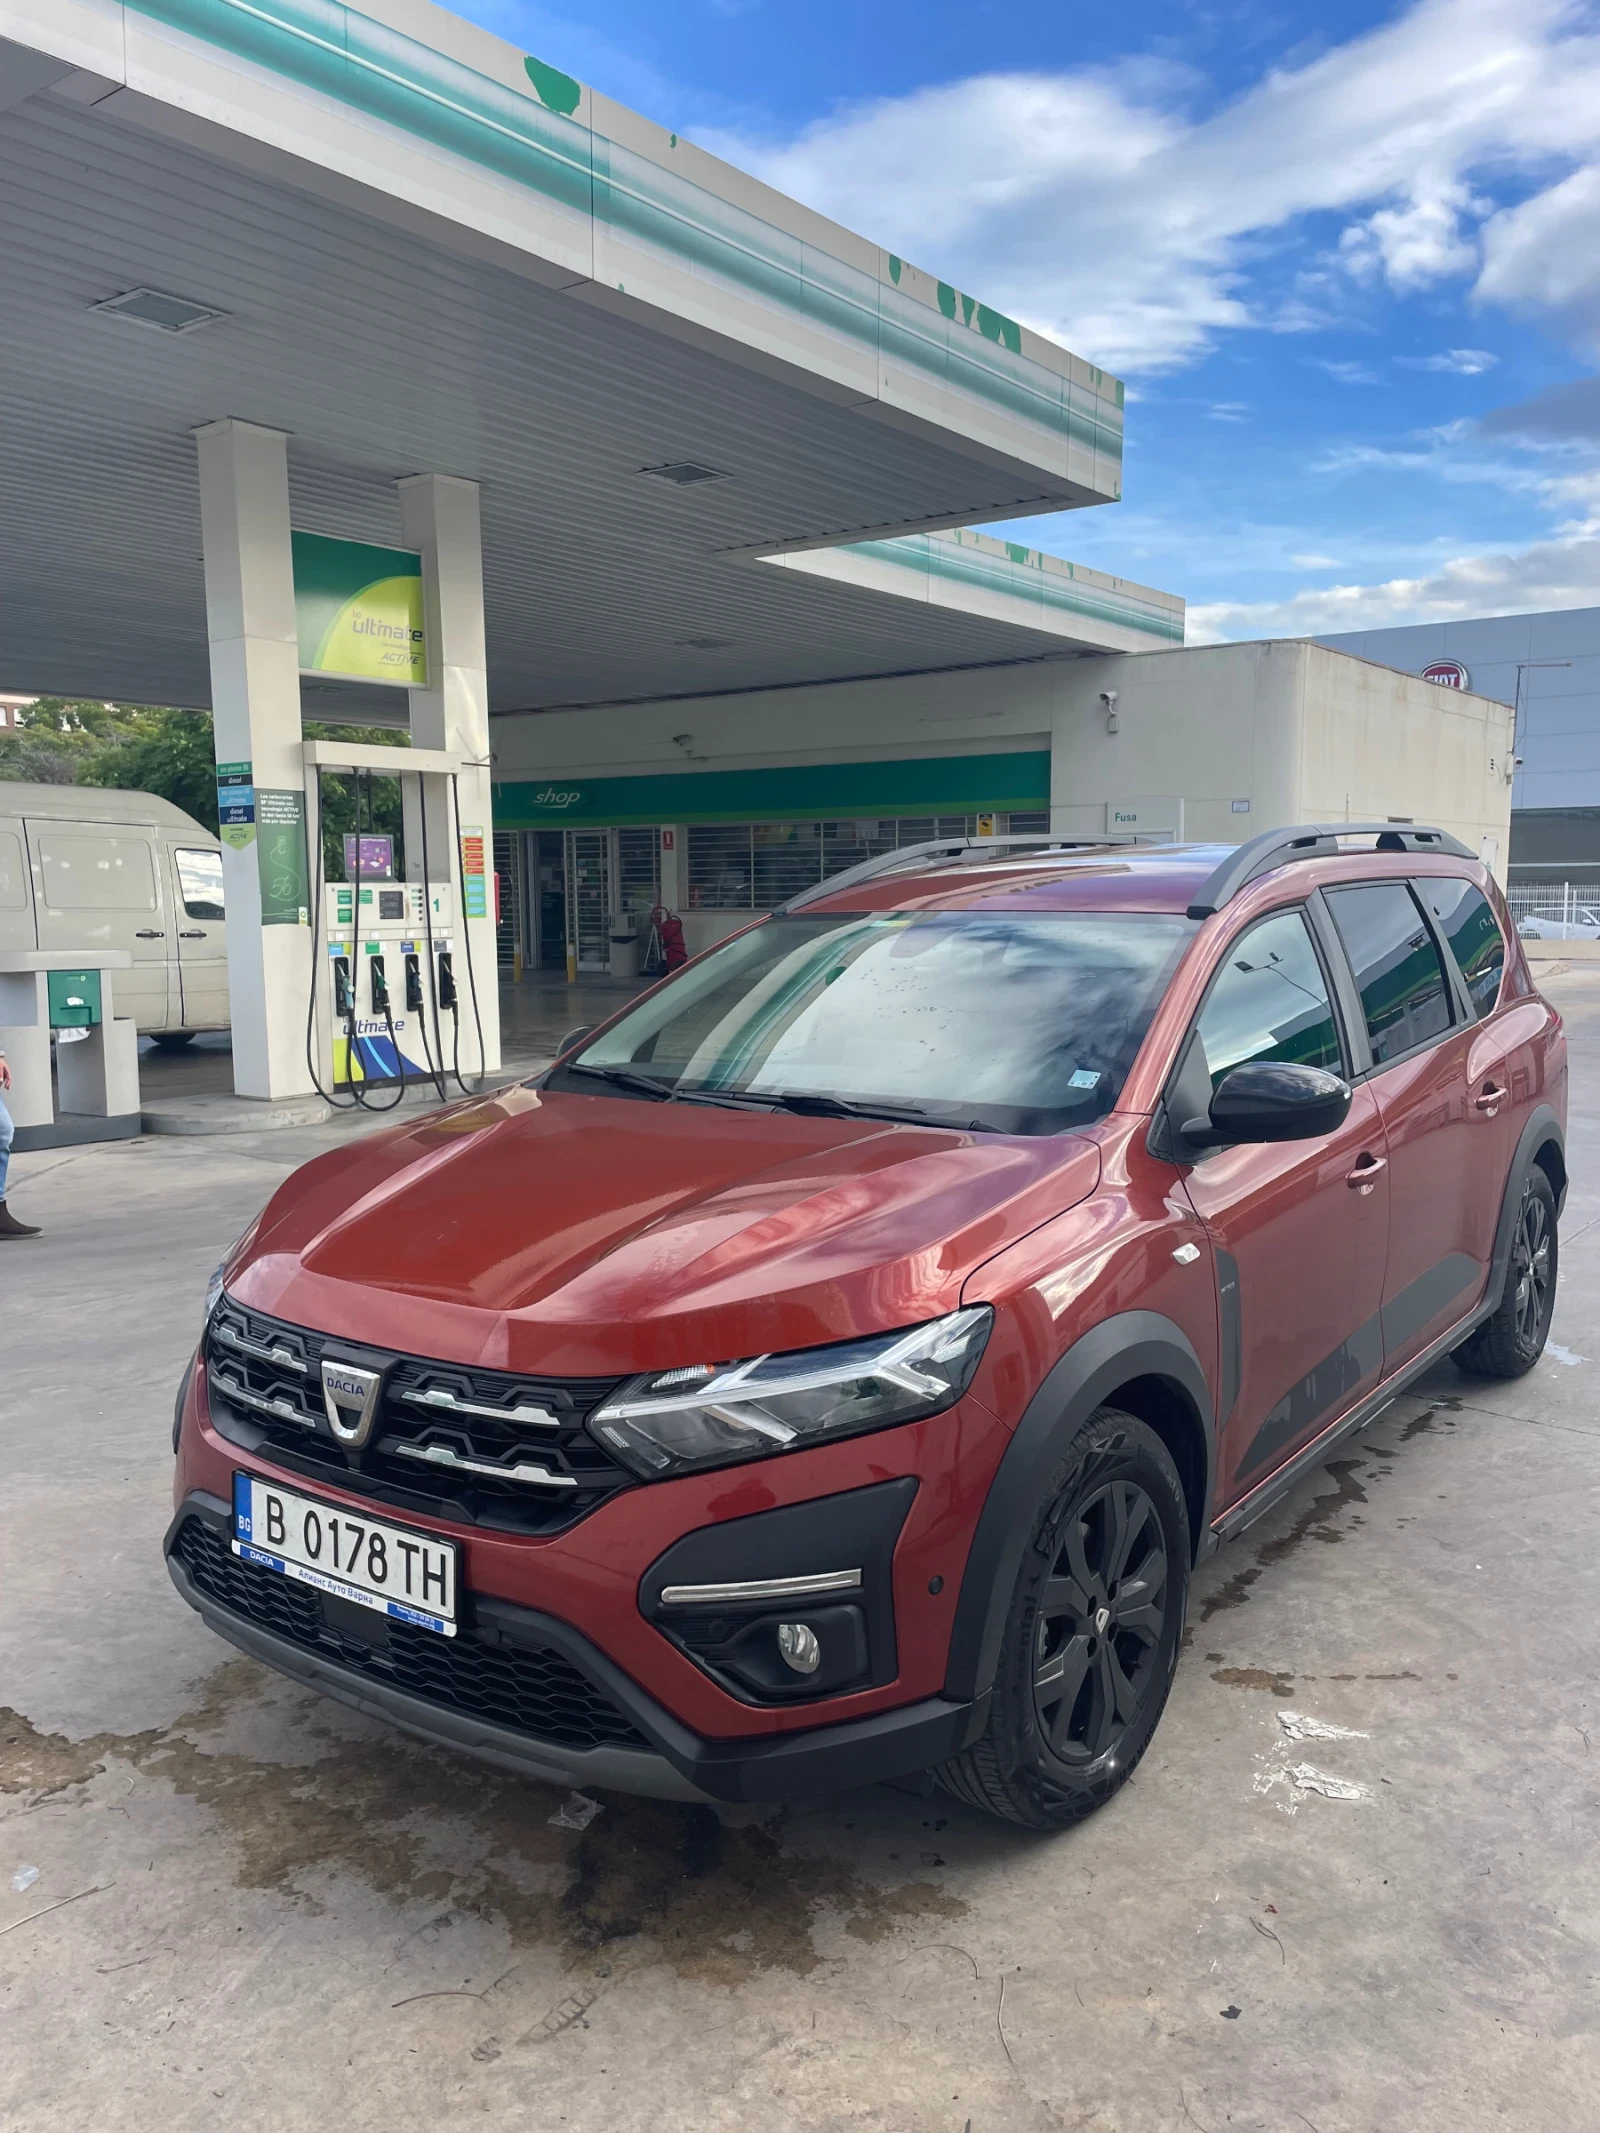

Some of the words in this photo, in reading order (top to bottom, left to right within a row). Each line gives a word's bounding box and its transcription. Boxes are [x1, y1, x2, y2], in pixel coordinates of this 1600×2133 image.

[352, 618, 423, 642] ultimate
[381, 652, 420, 665] ACTIVE
[1427, 674, 1457, 688] IAT
[533, 788, 580, 808] shop
[1114, 812, 1137, 822] Fusa
[433, 898, 440, 912] 1
[343, 1019, 405, 1035] utimae
[327, 1376, 365, 1397] DACIA
[238, 1514, 251, 1532] BG
[250, 1551, 274, 1567] DACIA
[267, 1494, 285, 1545] B
[304, 1510, 388, 1584] 0178
[397, 1539, 446, 1607] TH
[299, 1569, 326, 1588] Алианс
[327, 1580, 346, 1595] Ауто
[348, 1587, 373, 1605] Варна
